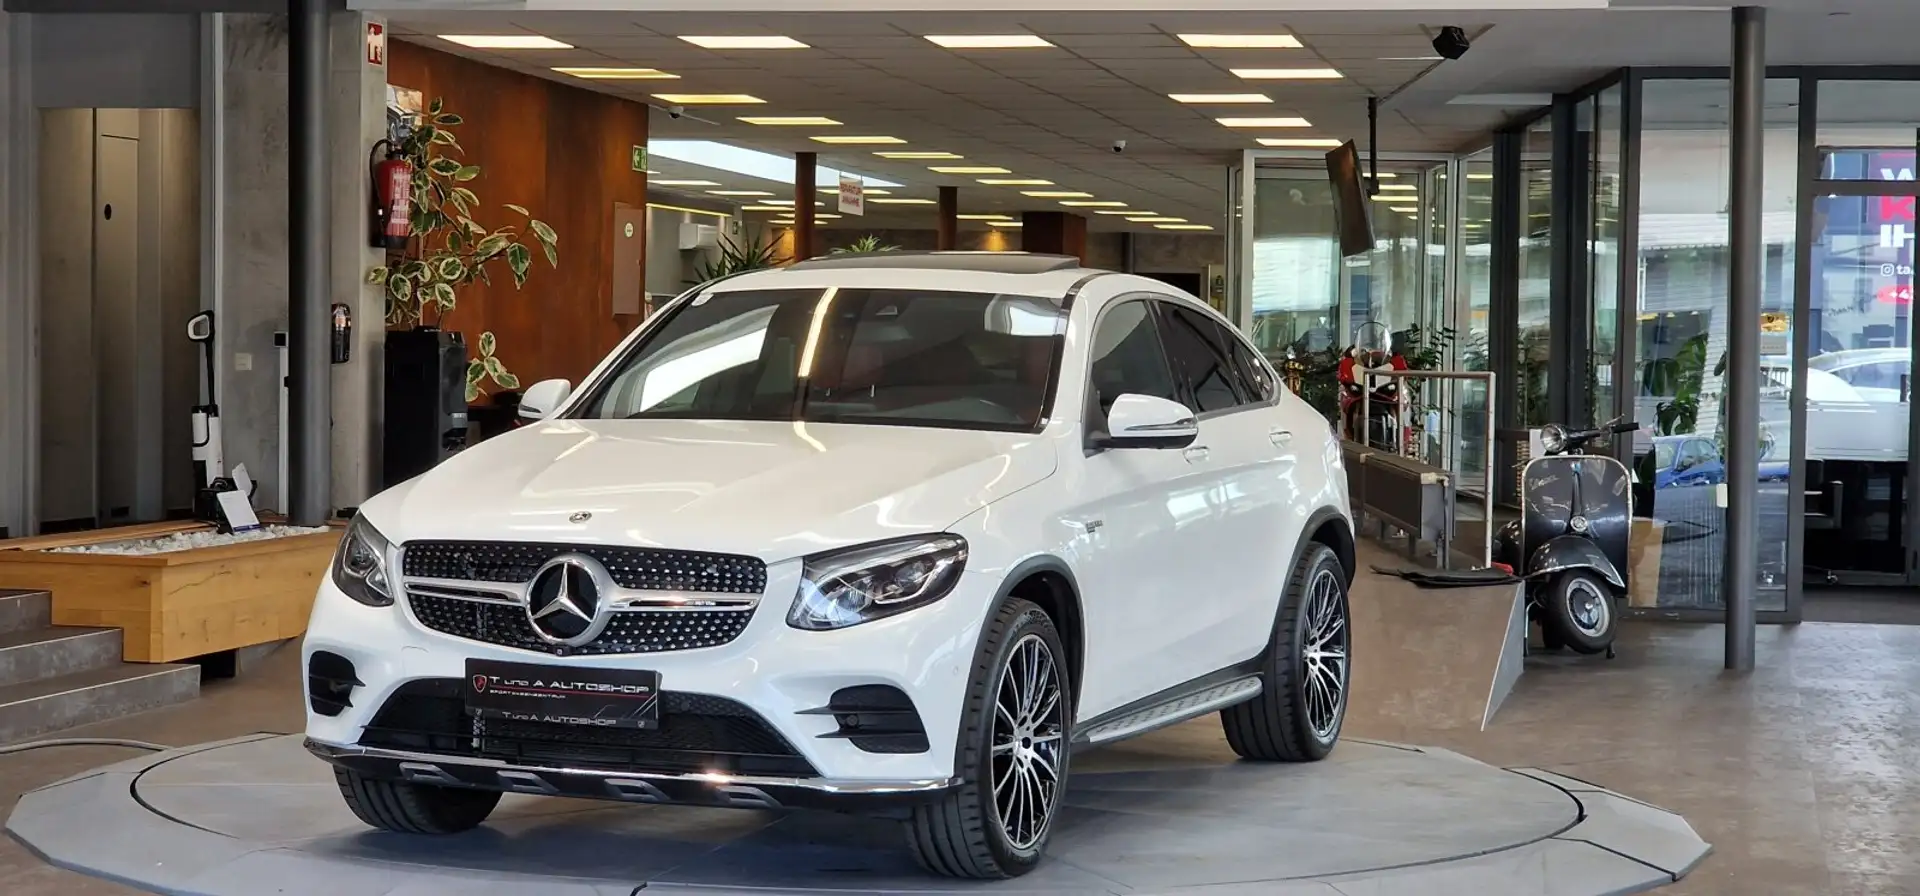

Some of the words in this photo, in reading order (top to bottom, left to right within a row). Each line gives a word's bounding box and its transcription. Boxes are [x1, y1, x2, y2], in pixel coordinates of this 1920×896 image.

[533, 680, 545, 688] A
[550, 681, 649, 693] AUTOSHOP
[543, 715, 616, 726] AUTOSHOP
